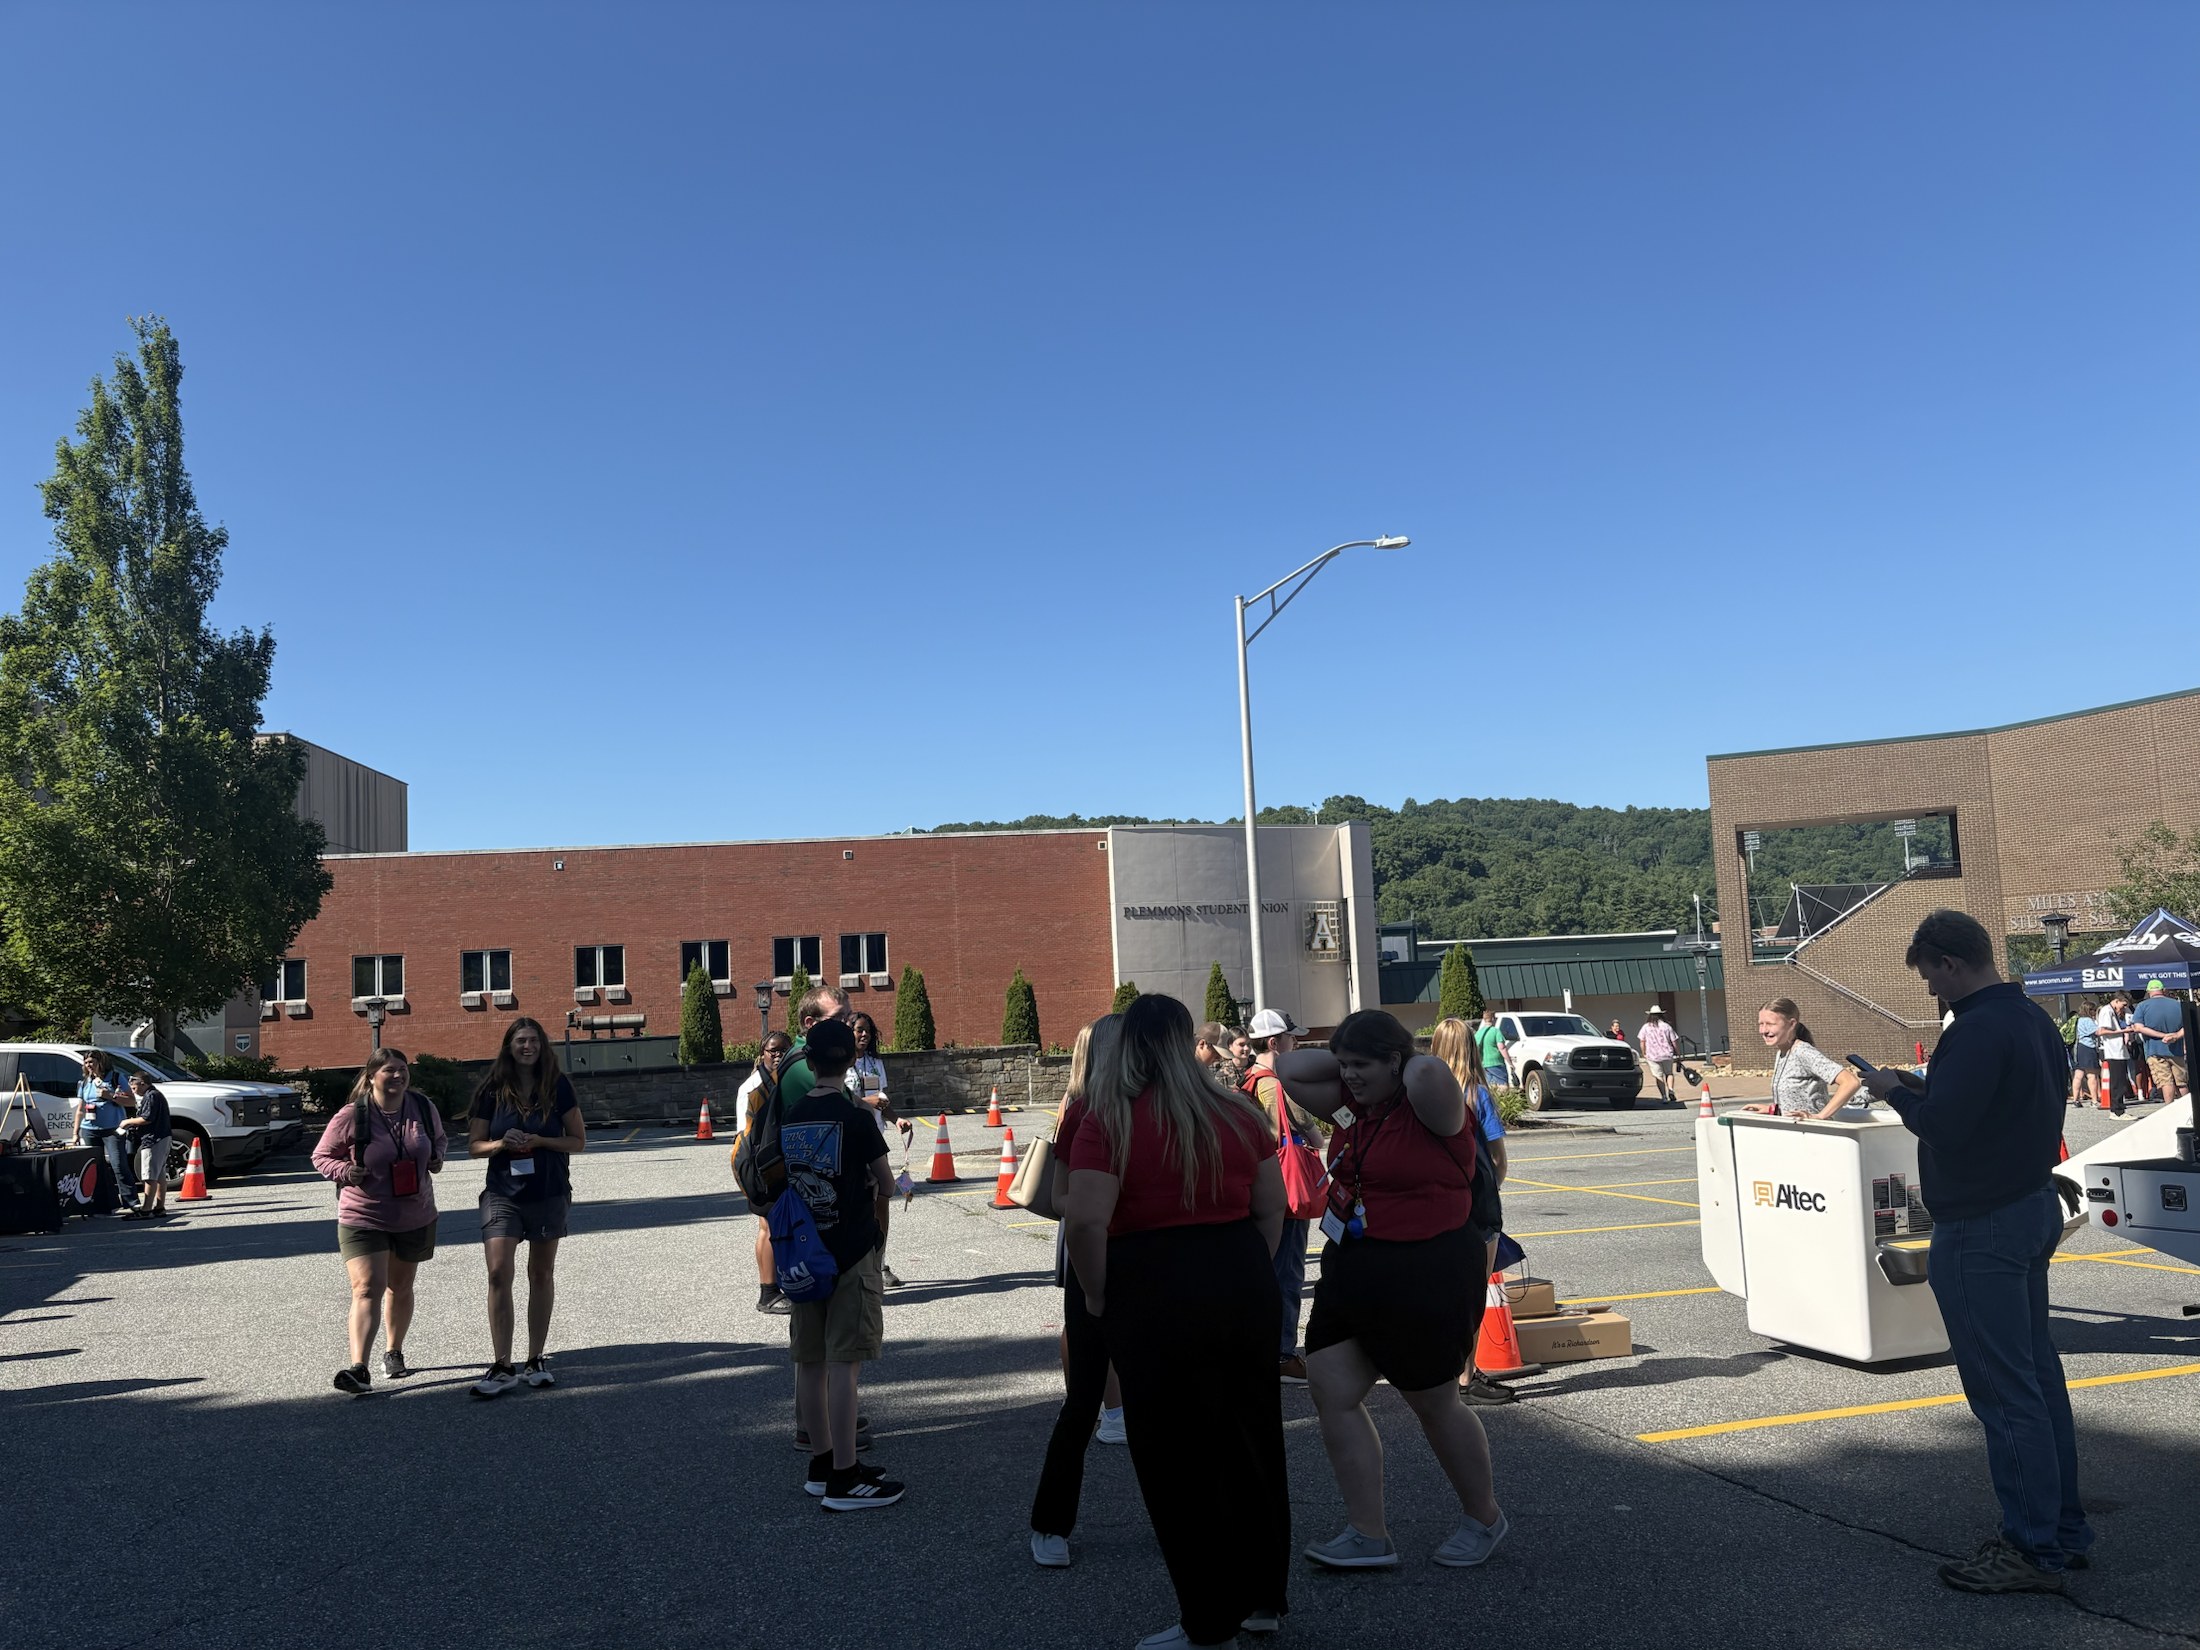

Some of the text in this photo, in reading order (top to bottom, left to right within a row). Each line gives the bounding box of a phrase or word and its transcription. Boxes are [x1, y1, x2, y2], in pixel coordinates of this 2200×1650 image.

[1123, 902, 1289, 918] PLEMMONS STUDENT NION
[2027, 894, 2077, 911] MILES
[2081, 967, 2124, 982] S&N
[47, 1112, 73, 1121] DUKE
[47, 1121, 75, 1130] ENER
[1776, 1183, 1826, 1212] Altec
[1567, 1338, 1600, 1348] Richardson
